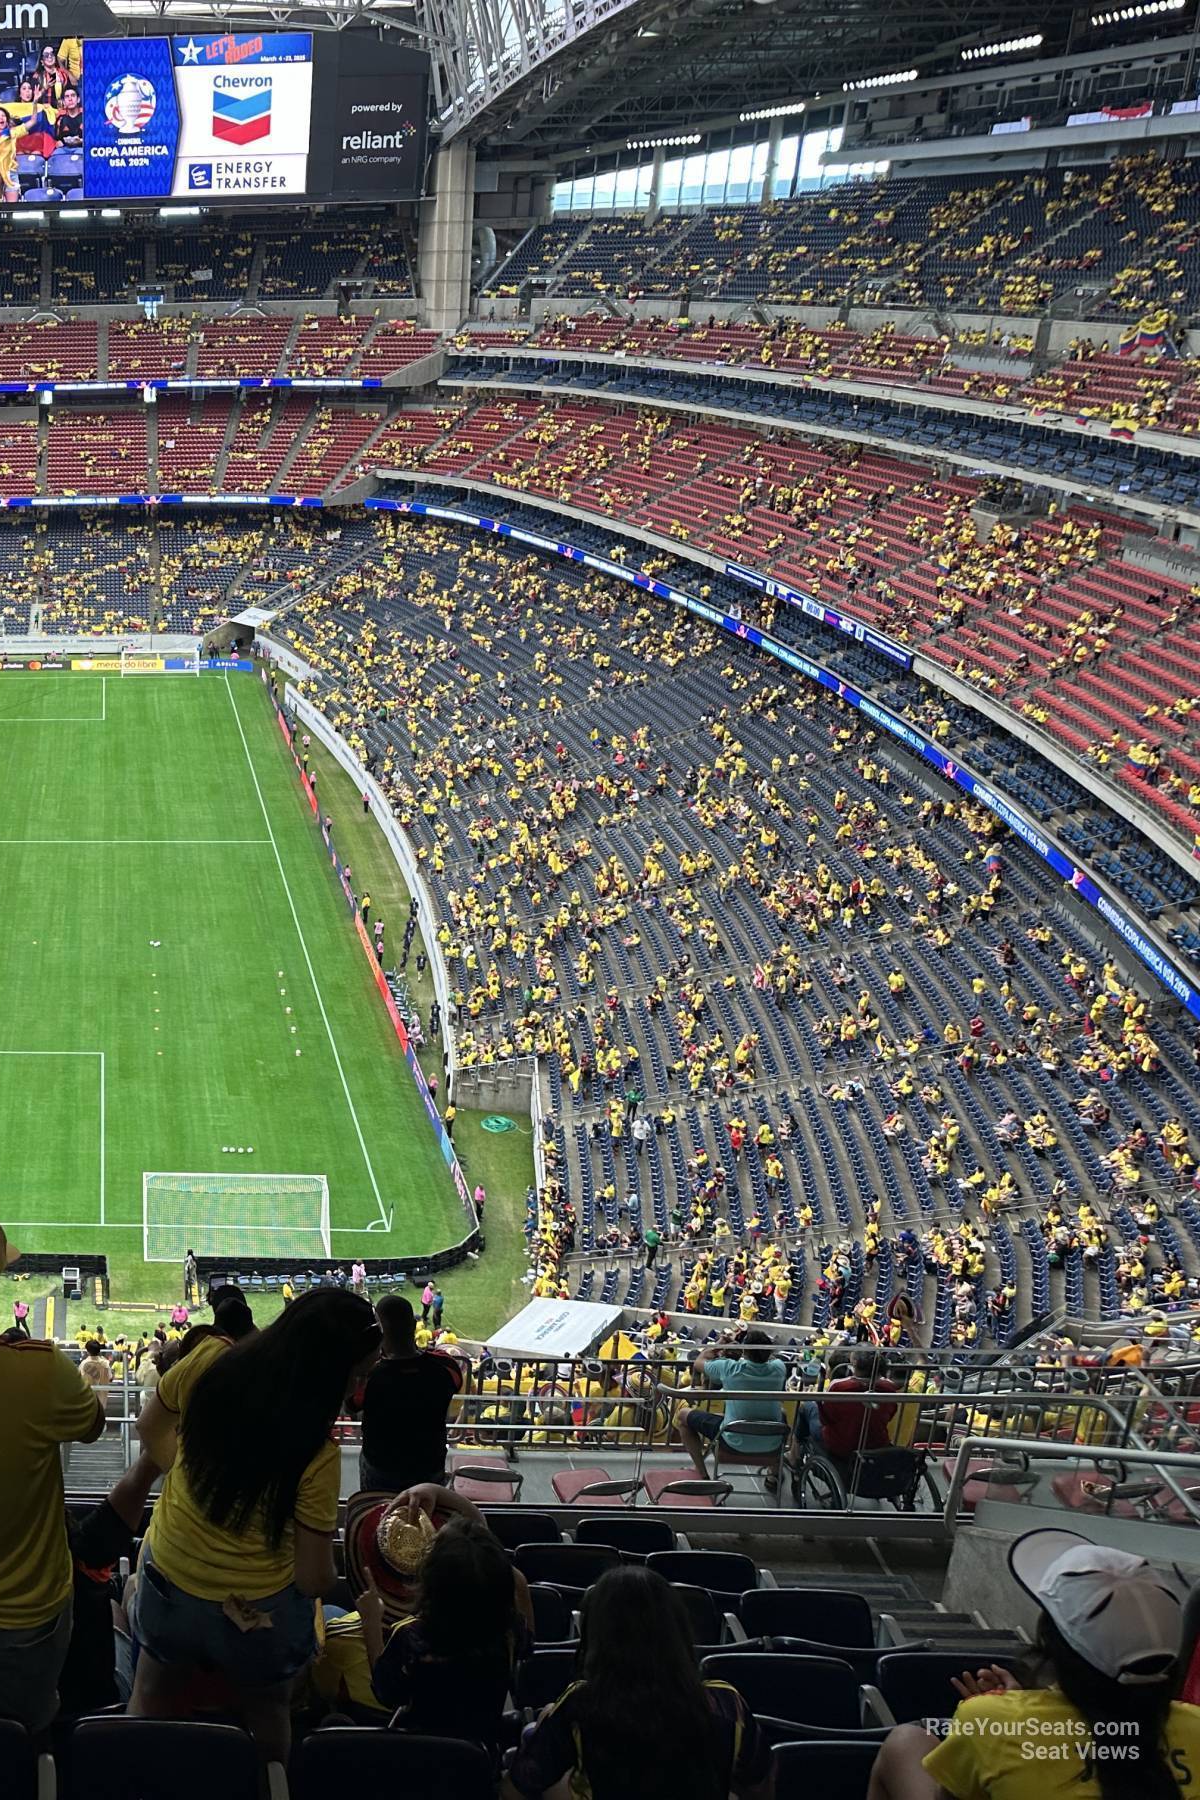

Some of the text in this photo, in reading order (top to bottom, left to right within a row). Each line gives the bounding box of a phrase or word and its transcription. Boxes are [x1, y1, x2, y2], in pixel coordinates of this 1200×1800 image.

[213, 75, 273, 89] Chevron
[351, 103, 403, 115] powered by
[342, 132, 403, 150] reliant
[90, 145, 169, 157] COPA AMERICA
[109, 157, 150, 167] USA 2024
[351, 155, 368, 164] NRG
[369, 155, 401, 166] company
[216, 161, 273, 175] ENERGY
[216, 175, 287, 190] TRANSFER
[137, 660, 157, 668] libre
[973, 784, 1049, 856] CONMEBOL COPA AMERICA USA 2024
[1098, 897, 1191, 1002] CONMEBOL COPA AMERICA USA 2024
